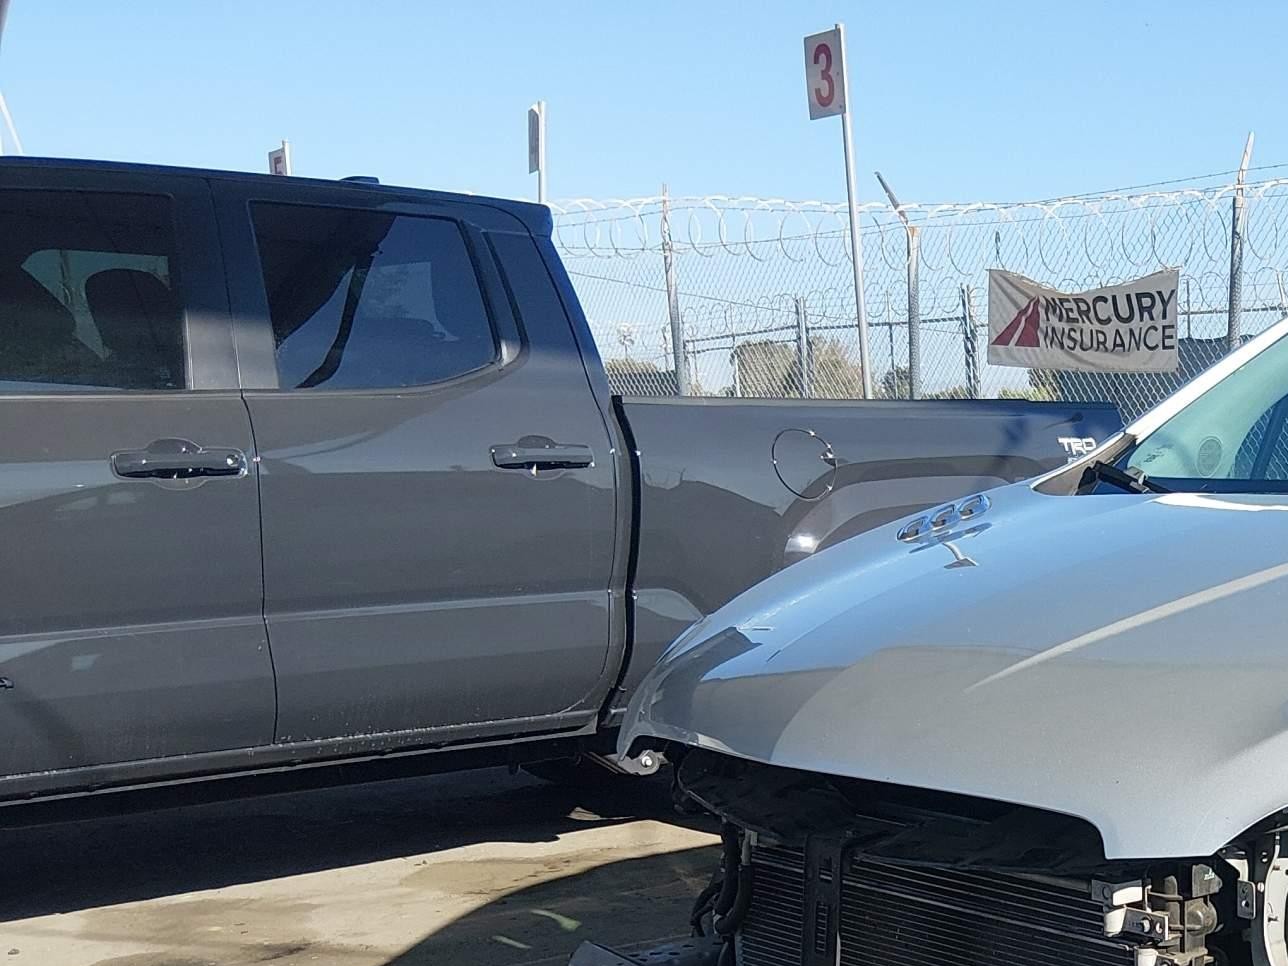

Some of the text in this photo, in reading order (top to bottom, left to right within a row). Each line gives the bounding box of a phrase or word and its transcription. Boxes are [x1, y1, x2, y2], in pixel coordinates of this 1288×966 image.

[813, 43, 835, 107] 3
[1043, 289, 1176, 326] MERCURY
[1043, 324, 1176, 353] INSURANCE
[1057, 437, 1097, 455] TRD
